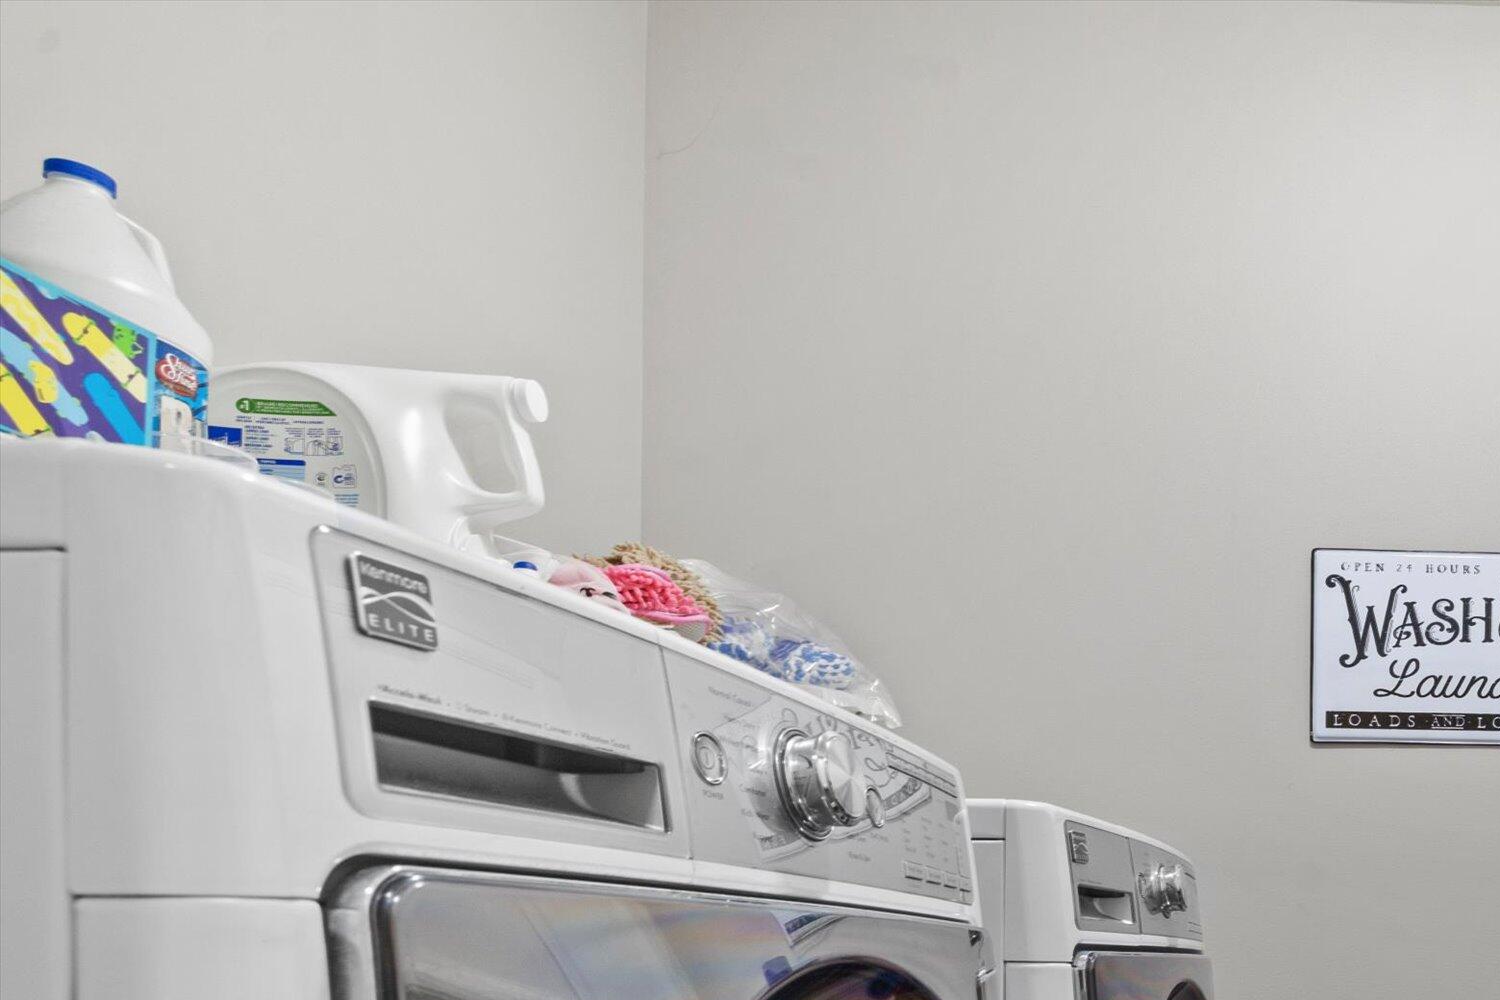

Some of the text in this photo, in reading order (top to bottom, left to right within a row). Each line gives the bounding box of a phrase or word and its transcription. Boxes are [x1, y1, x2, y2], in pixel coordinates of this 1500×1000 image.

[359, 561, 428, 595] Kenmore
[1340, 562, 1481, 575] OPEN 24 HOURS
[367, 612, 435, 643] ELITE
[1325, 574, 1496, 669] WASH
[1332, 713, 1416, 728] LOADS
[1430, 715, 1467, 729] AND
